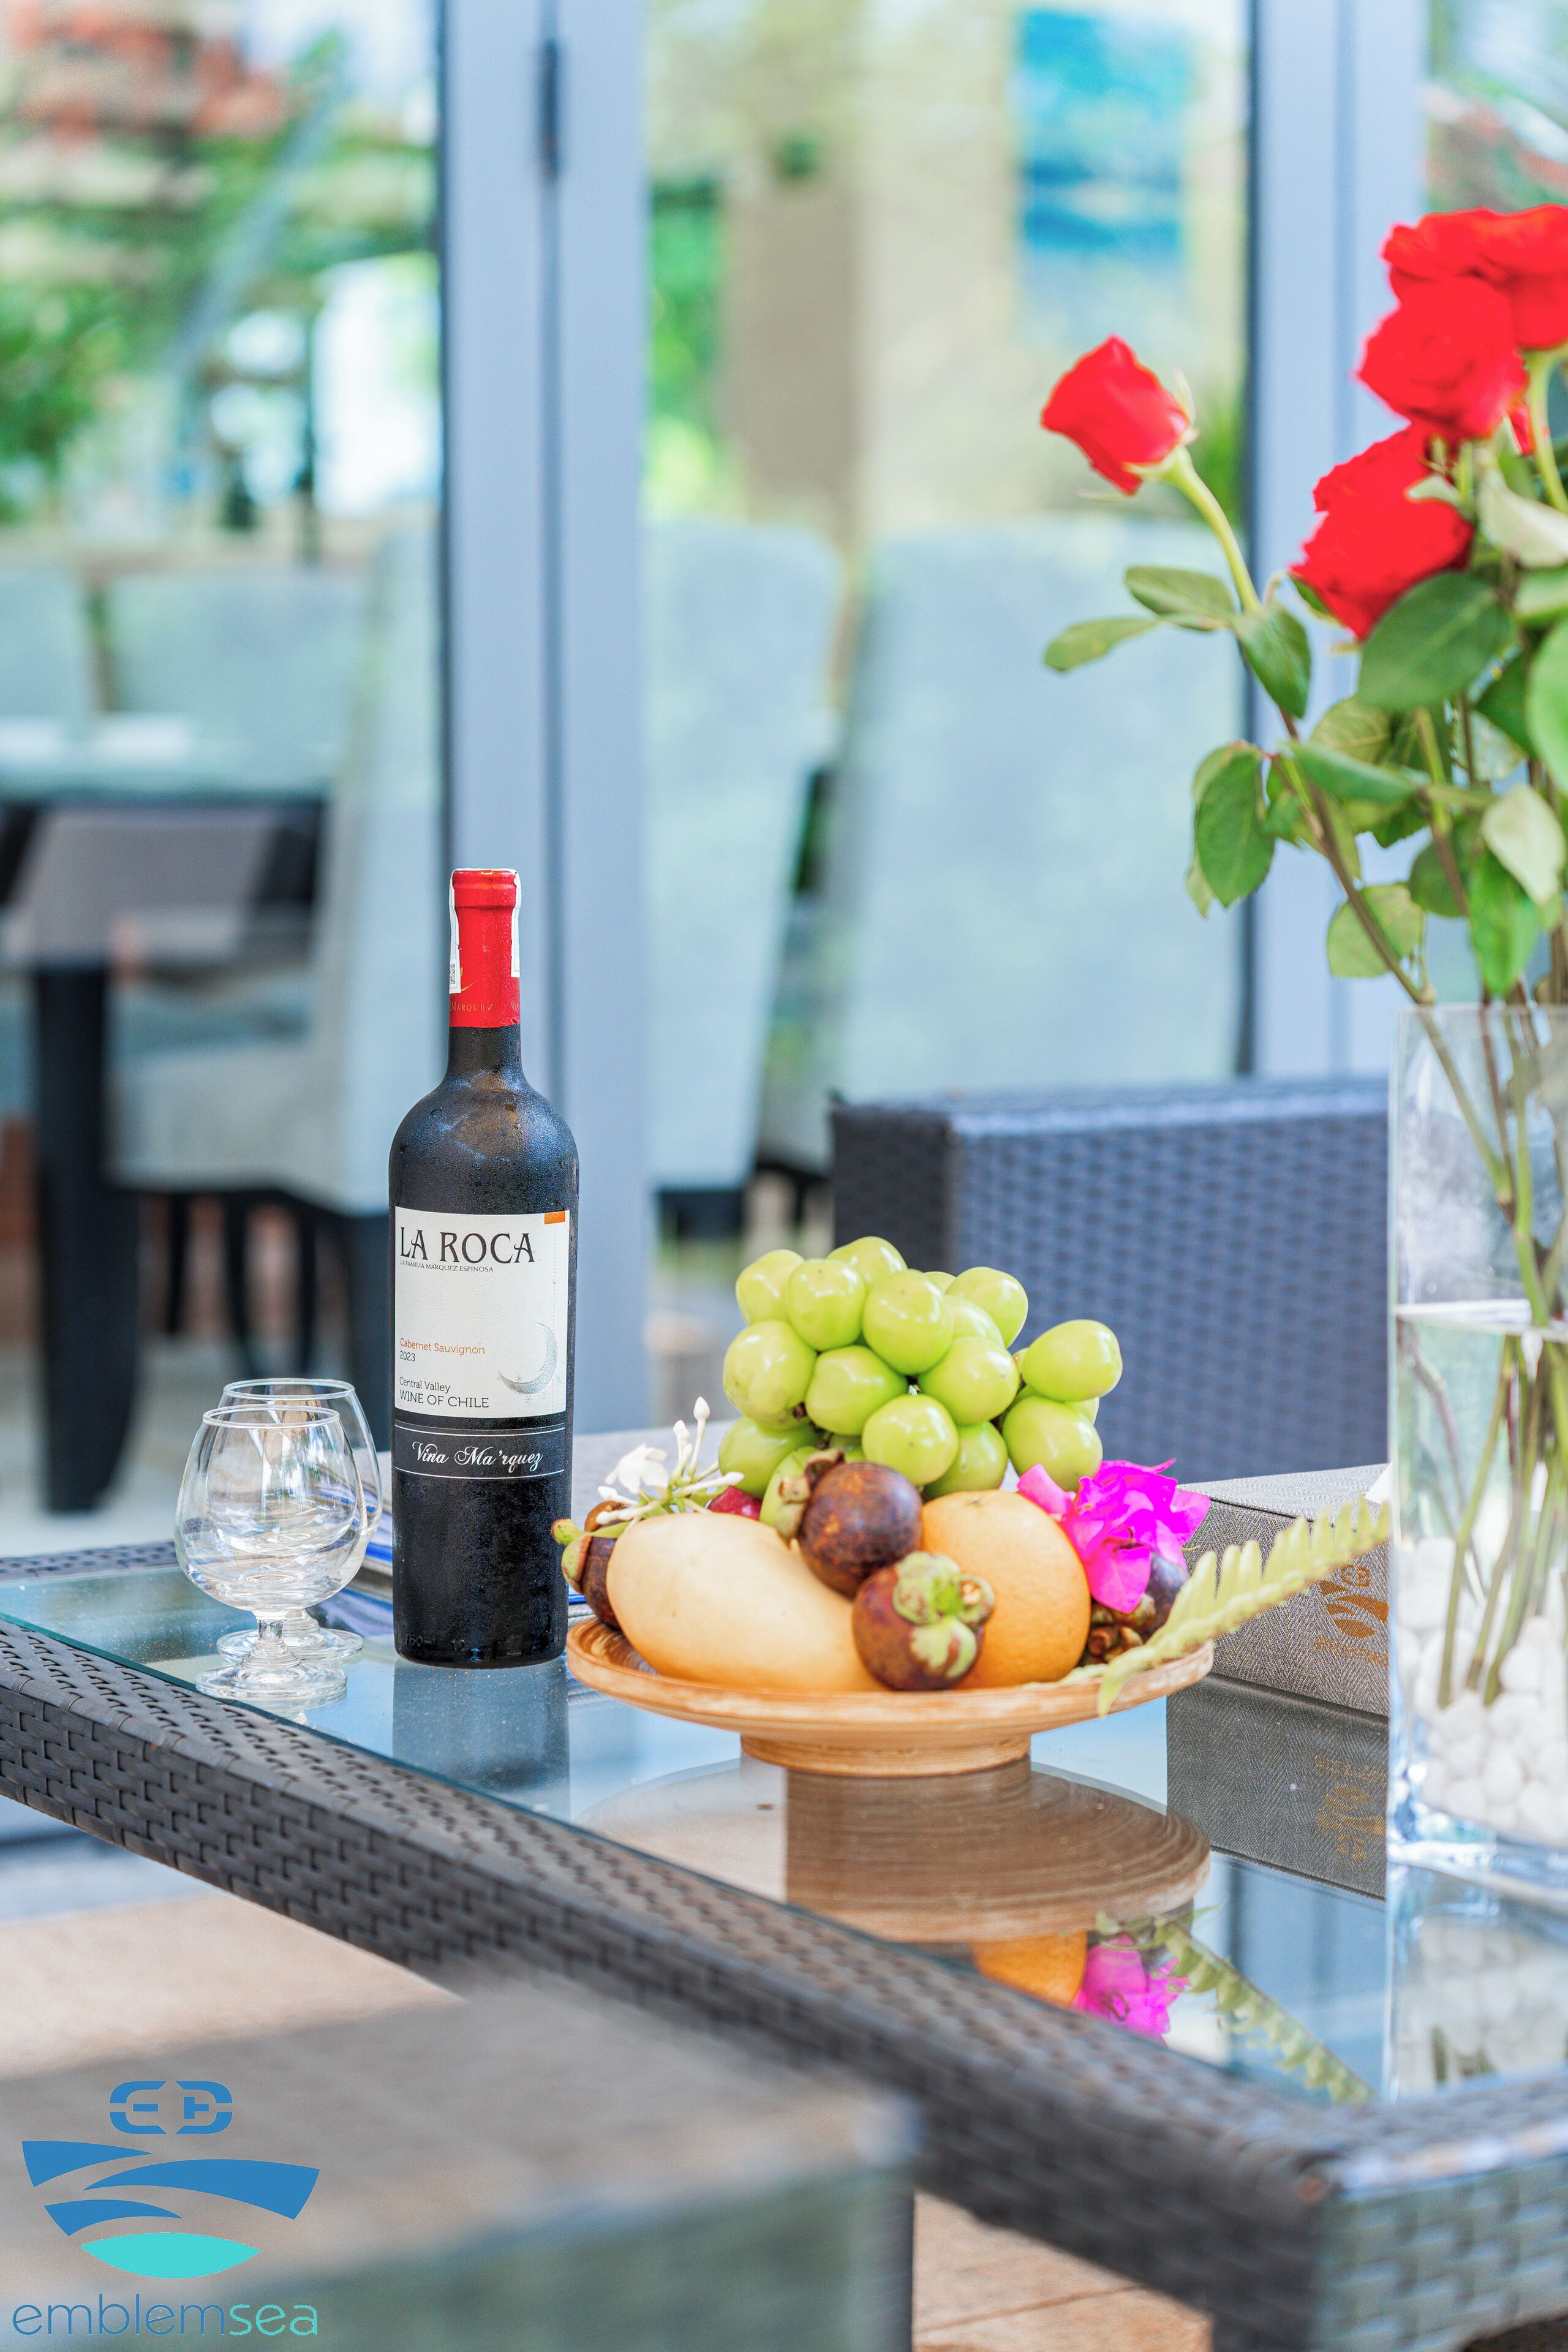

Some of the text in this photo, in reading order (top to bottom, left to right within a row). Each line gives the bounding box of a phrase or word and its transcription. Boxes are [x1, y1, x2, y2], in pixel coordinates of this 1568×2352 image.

[401, 1227, 535, 1264] LA ROCA
[400, 1338, 486, 1355] Cabernet Sauvignon
[399, 1351, 416, 1362] 2023
[399, 1376, 451, 1394] Central Valley
[399, 1389, 489, 1408] WINE OF CHILE
